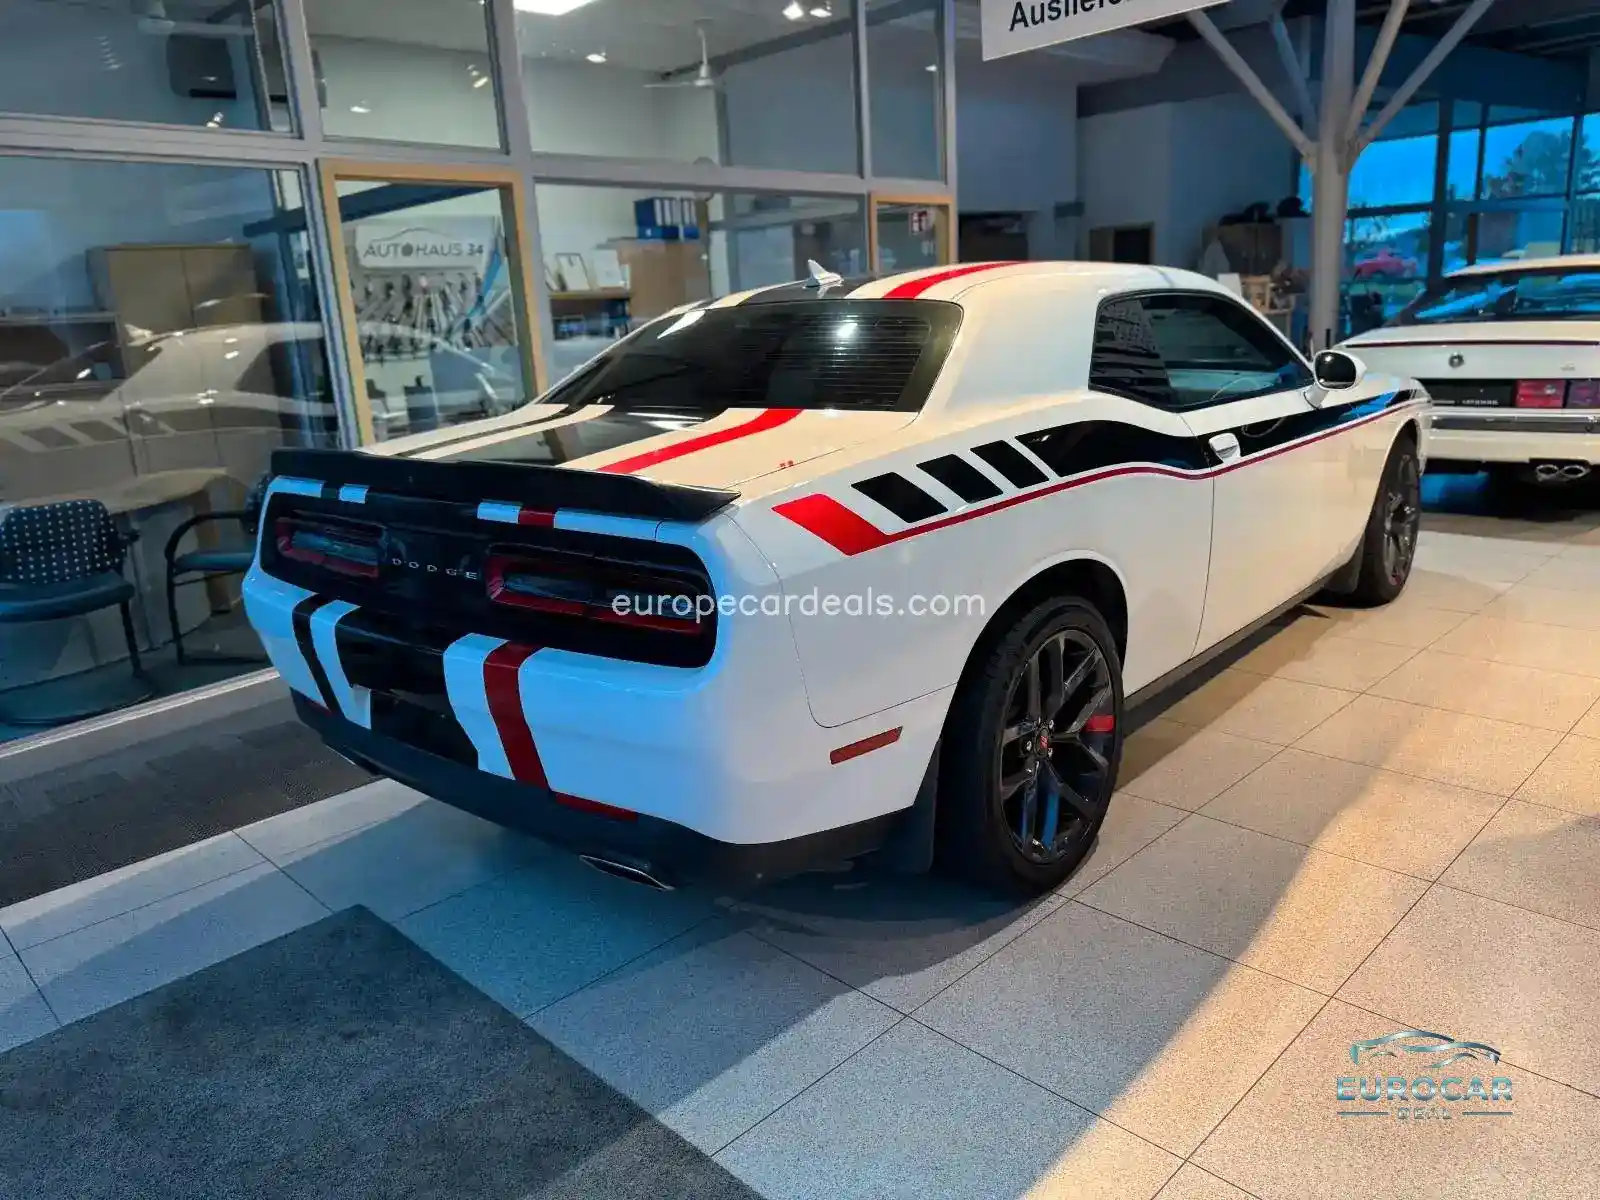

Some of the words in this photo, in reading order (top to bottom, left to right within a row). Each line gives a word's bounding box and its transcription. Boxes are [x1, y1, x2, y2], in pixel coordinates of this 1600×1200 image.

[363, 242, 462, 258] AUTOHAUS
[467, 243, 484, 256] 34
[391, 557, 477, 580] DODGE
